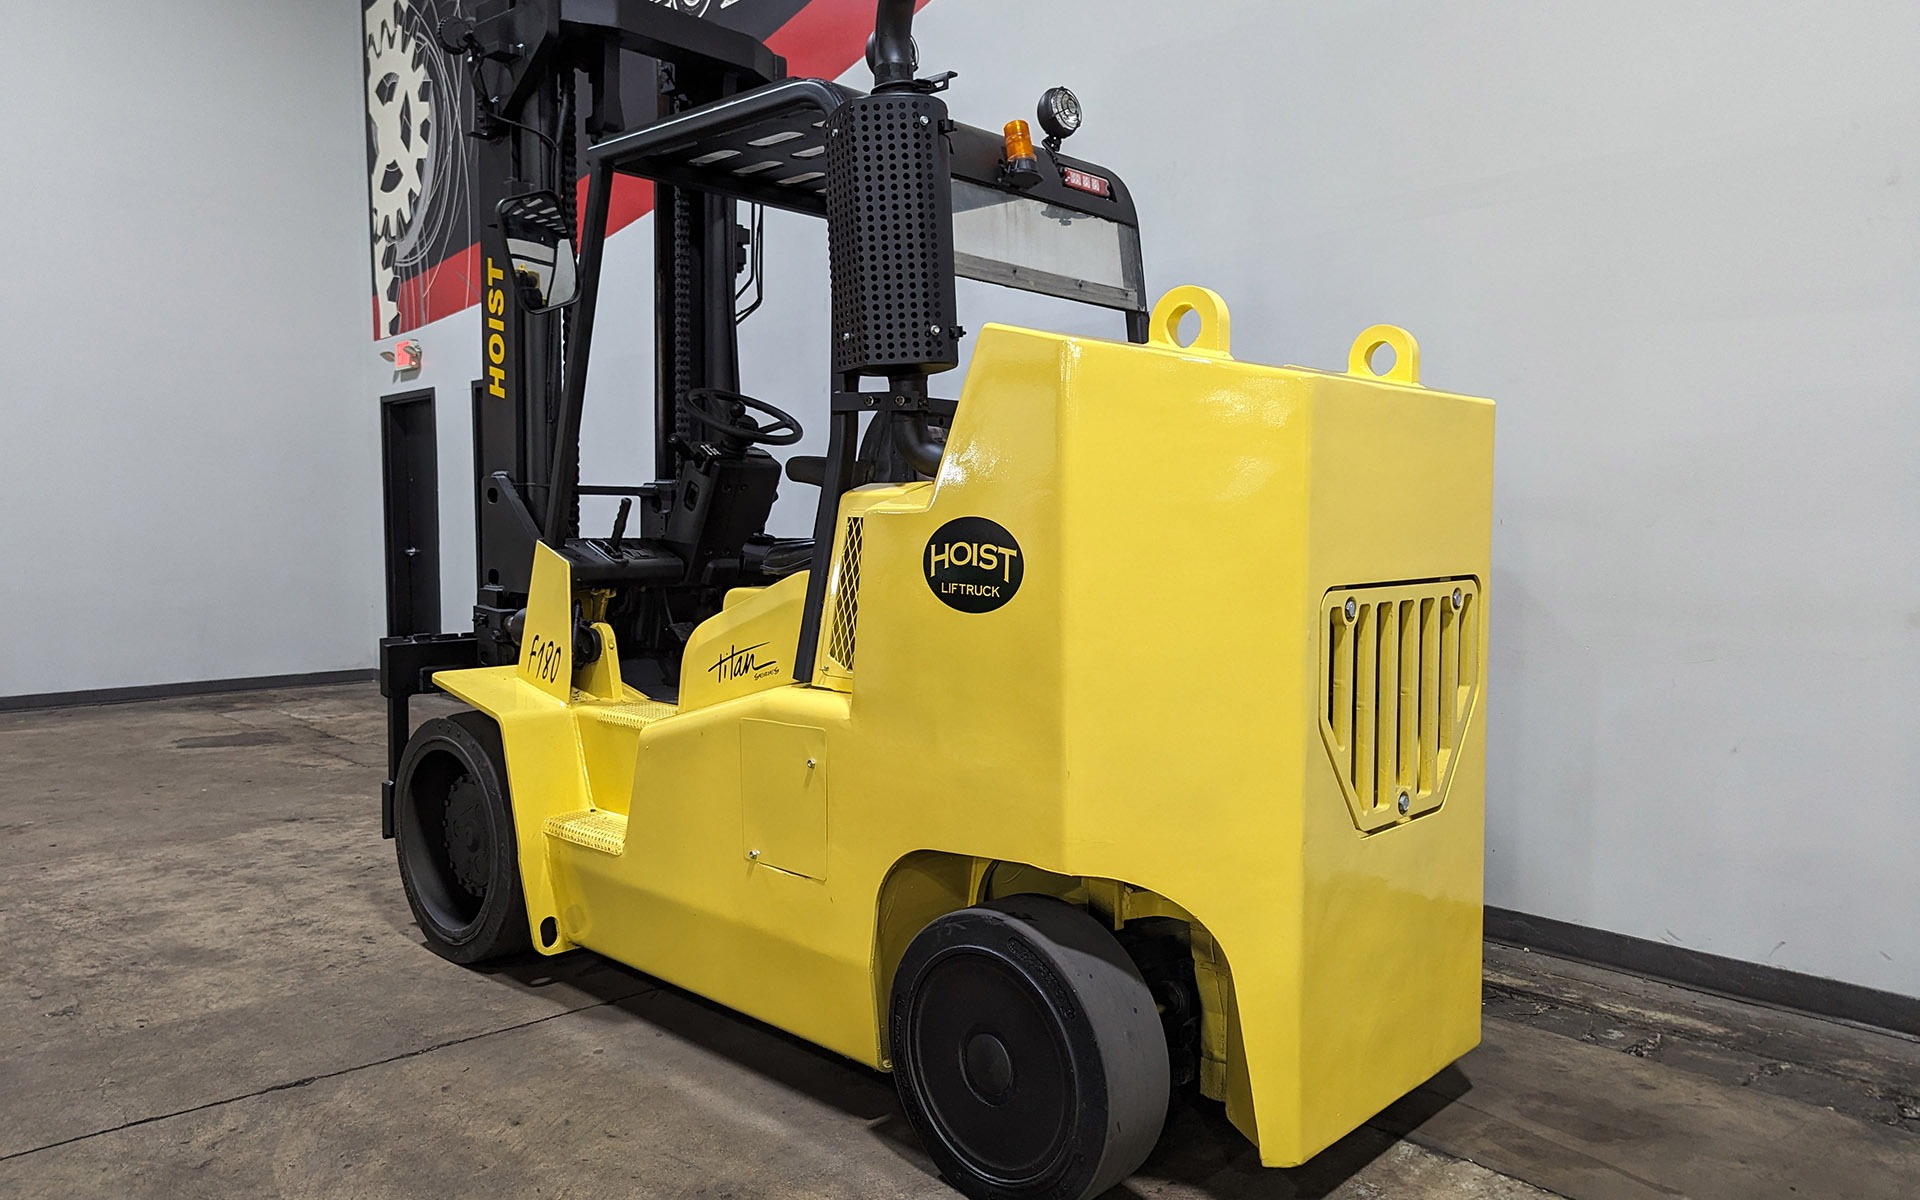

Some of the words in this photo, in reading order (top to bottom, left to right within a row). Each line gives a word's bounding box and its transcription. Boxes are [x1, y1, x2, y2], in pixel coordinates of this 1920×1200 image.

[487, 257, 506, 399] HOIST
[930, 541, 1017, 583] HOIST
[941, 582, 1000, 598] LIFTRUCK
[527, 634, 561, 684] F180
